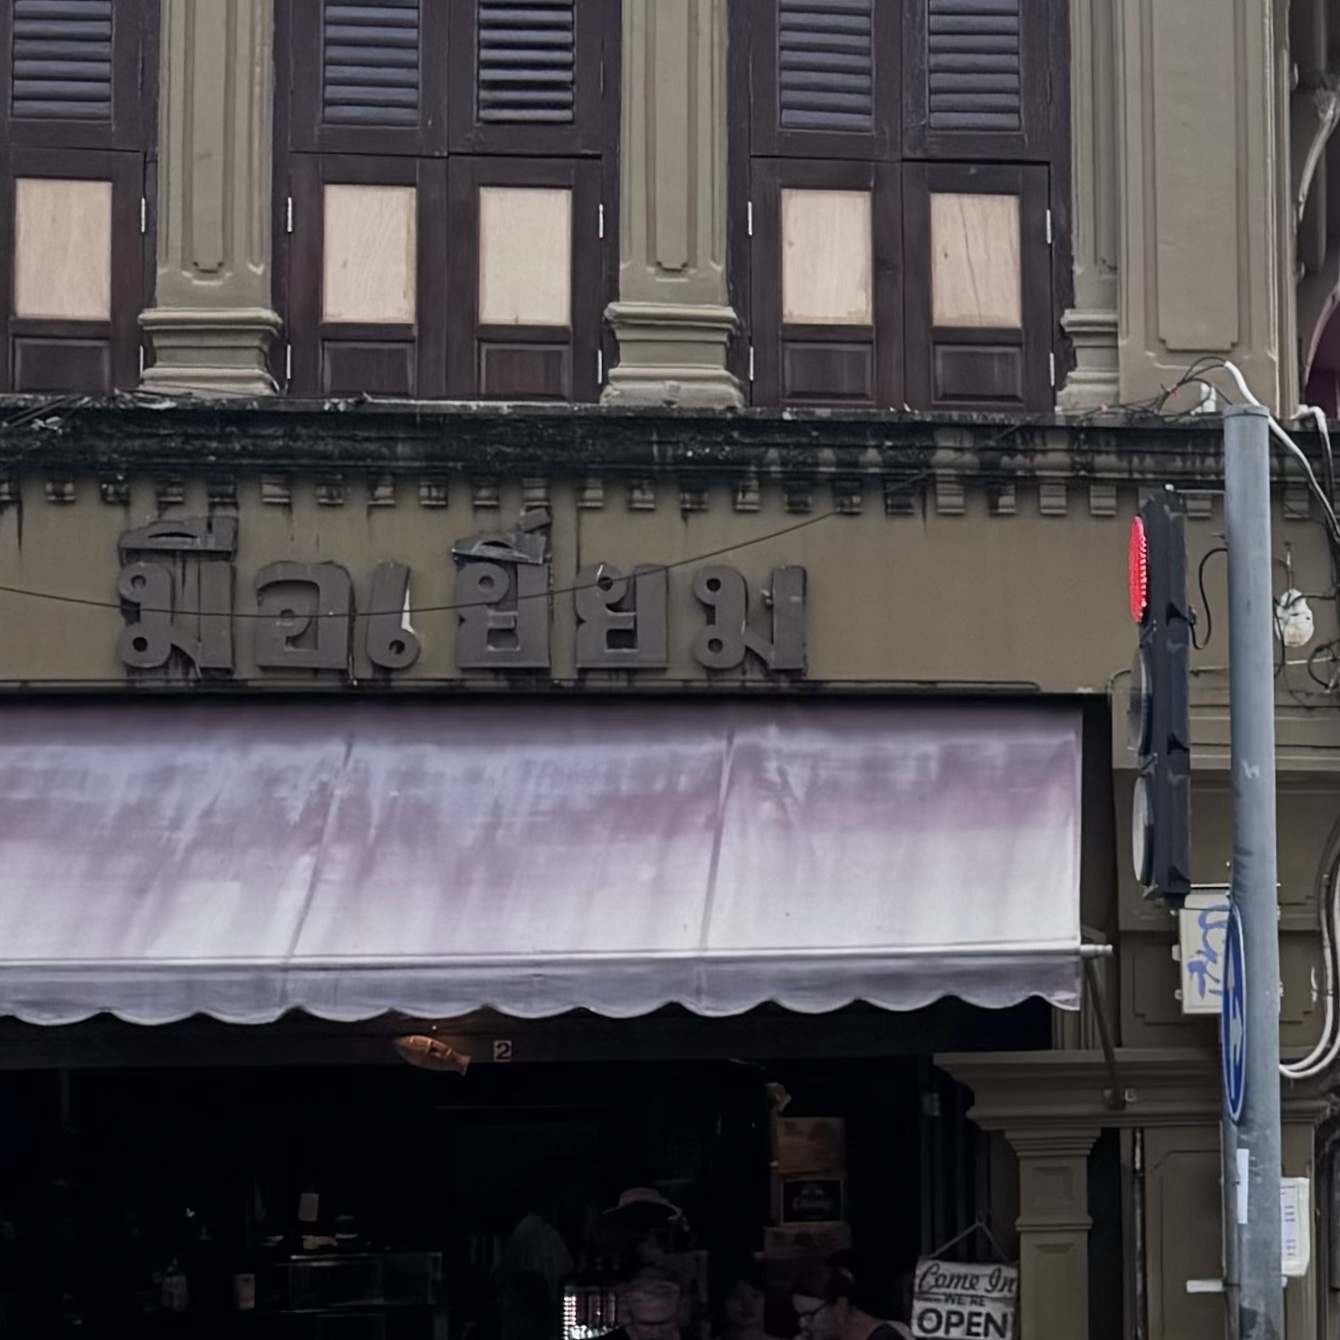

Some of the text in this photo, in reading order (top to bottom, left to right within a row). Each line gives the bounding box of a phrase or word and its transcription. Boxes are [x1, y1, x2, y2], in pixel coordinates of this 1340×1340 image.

[496, 1043, 509, 1060] 2
[919, 1262, 1016, 1293] Come In
[917, 1308, 1008, 1339] OPEN
